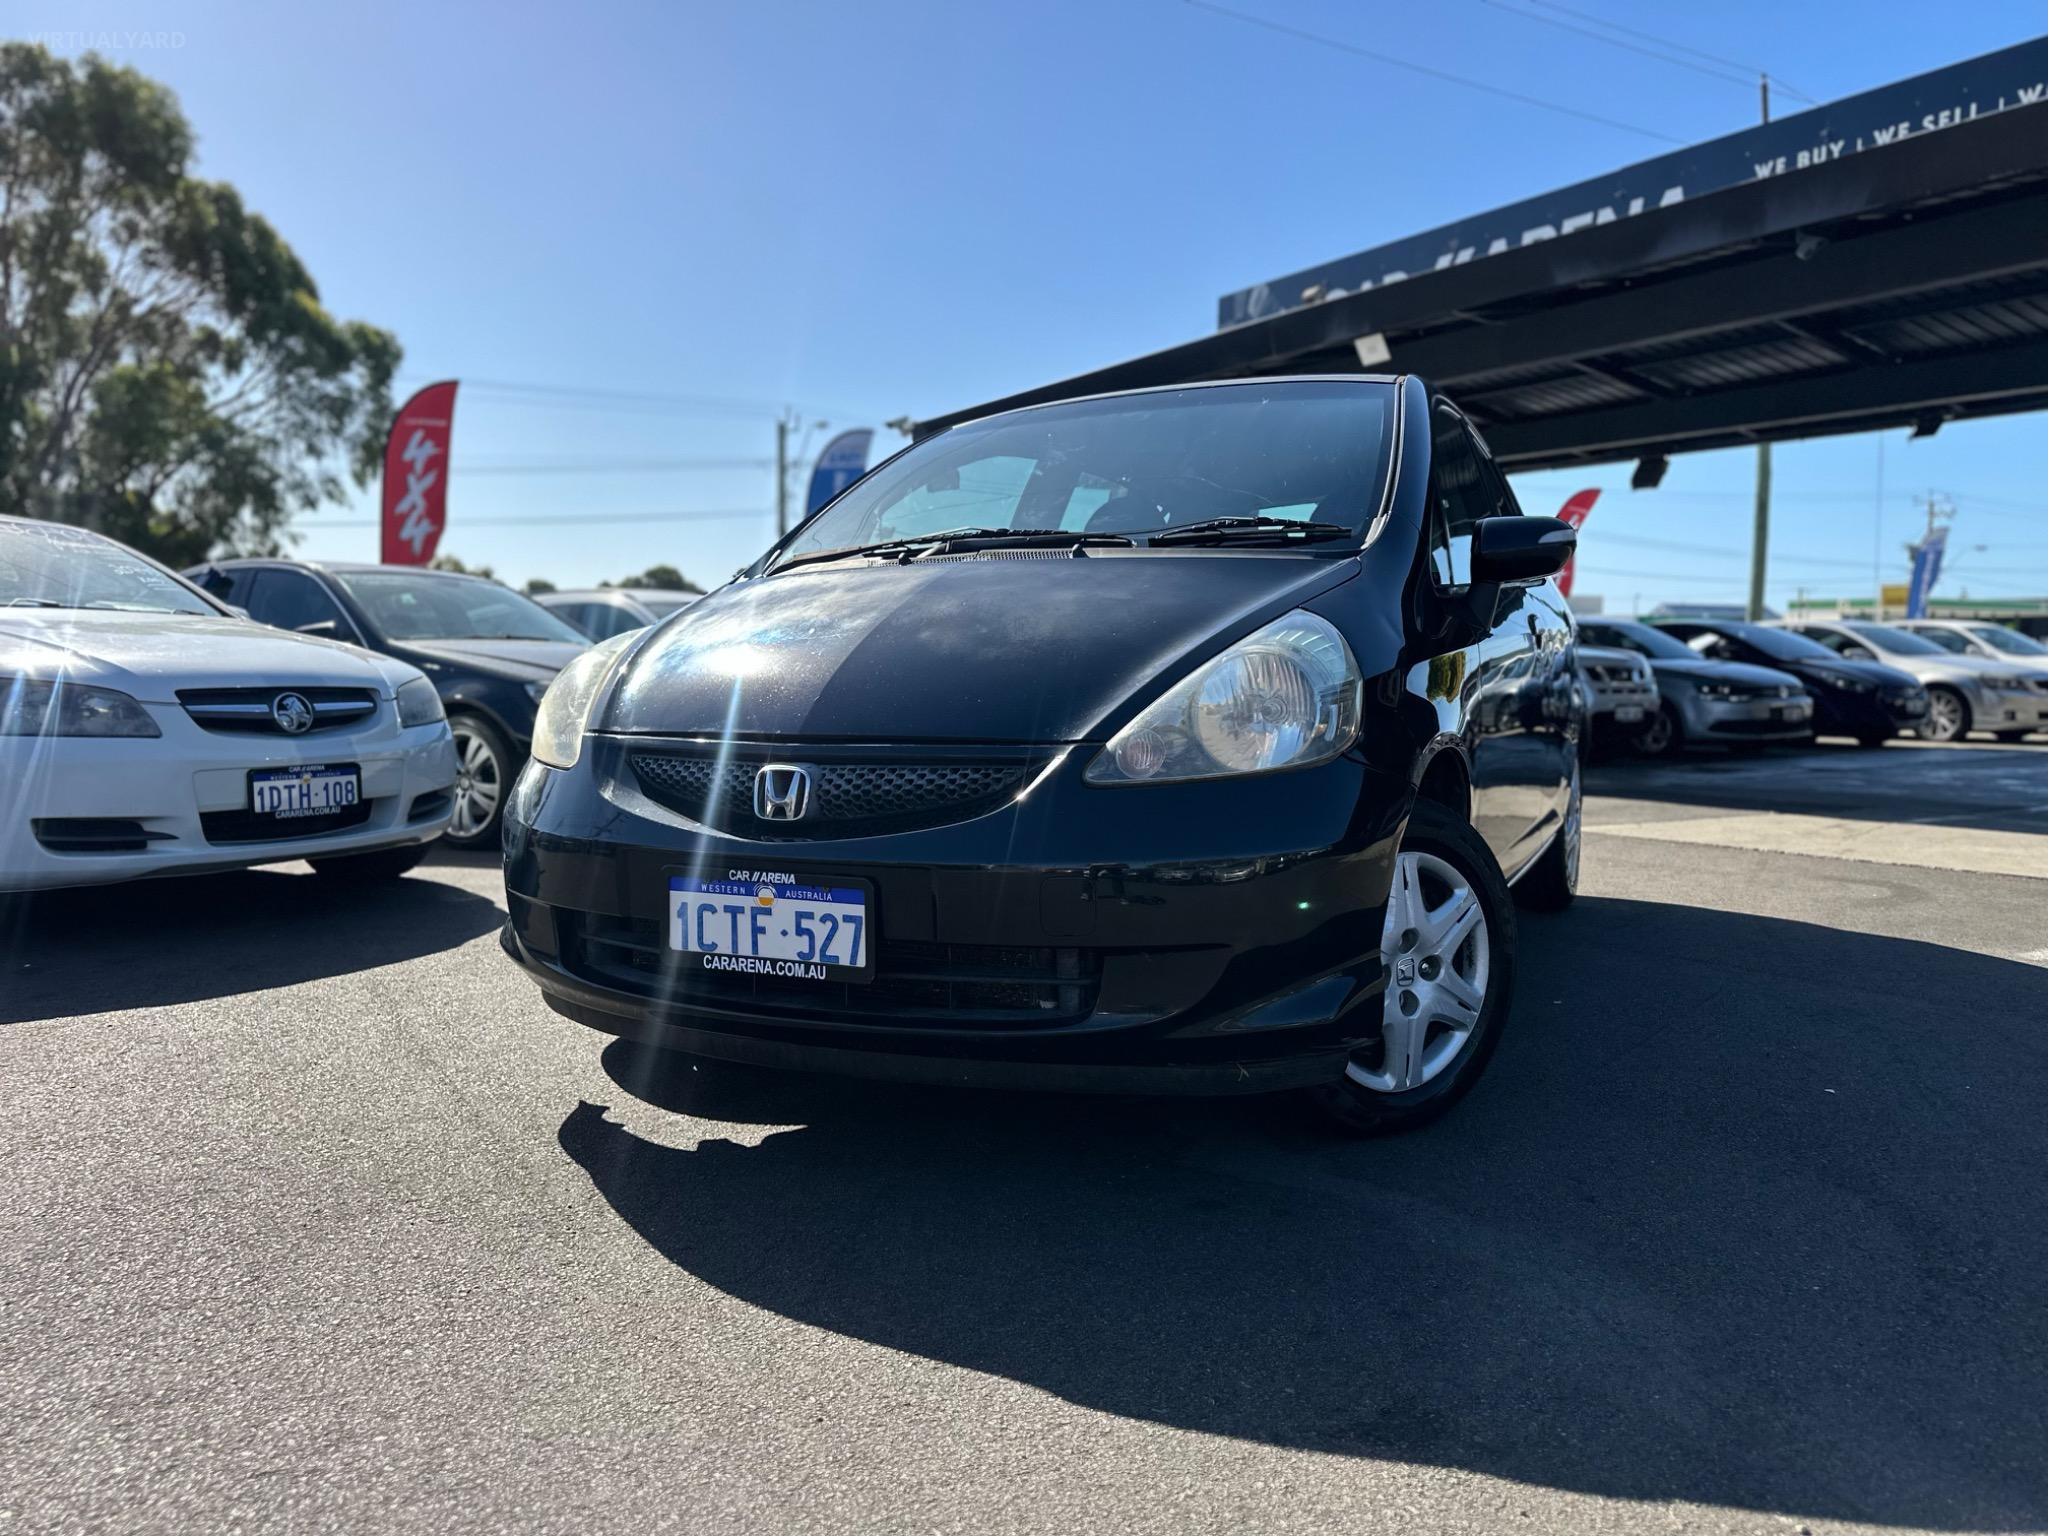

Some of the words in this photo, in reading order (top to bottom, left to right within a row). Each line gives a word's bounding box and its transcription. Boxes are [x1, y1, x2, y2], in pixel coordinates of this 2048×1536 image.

[1797, 140, 1845, 169] BUY
[275, 806, 341, 819] CARARENA.COM.AU
[729, 869, 750, 882] CAR
[701, 883, 746, 895] WESTERN
[785, 890, 833, 902] AUSTRALIA
[703, 955, 827, 980] CARARENA.COM.AU
